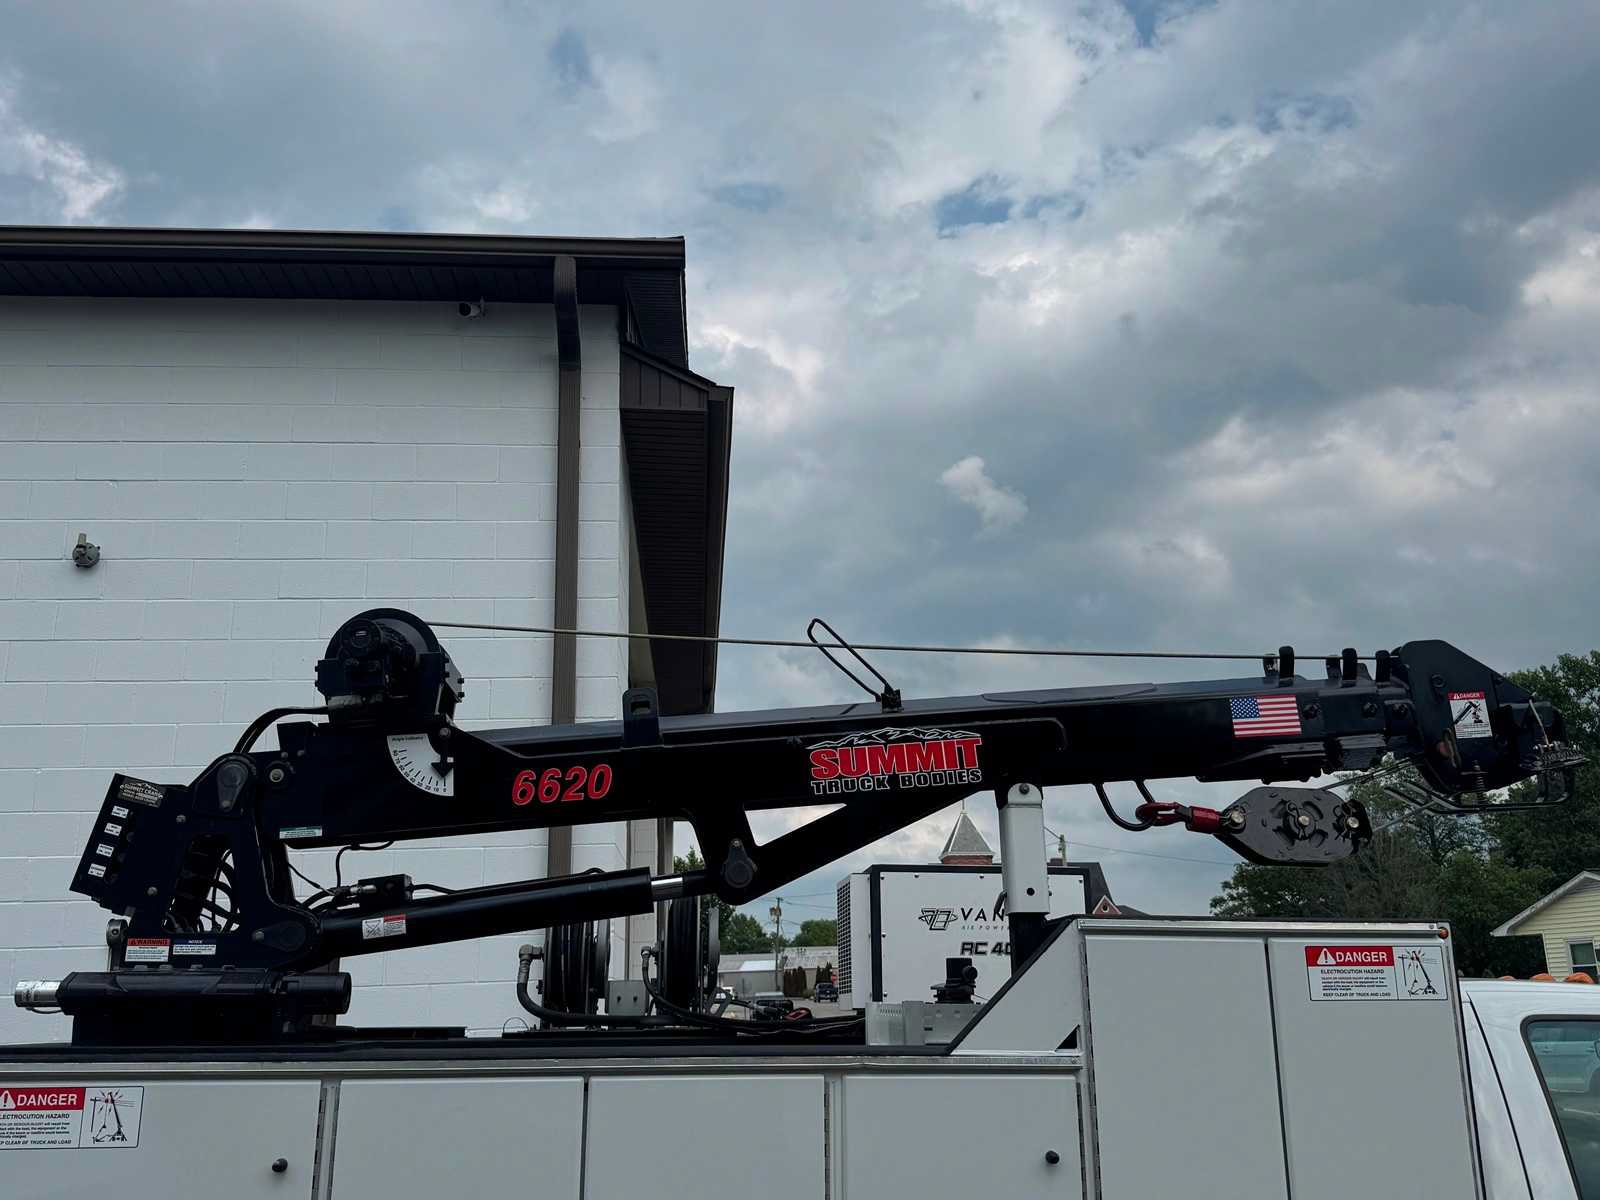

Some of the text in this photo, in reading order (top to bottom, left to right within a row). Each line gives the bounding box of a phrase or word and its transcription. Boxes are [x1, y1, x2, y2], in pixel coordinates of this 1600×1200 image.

[809, 738, 983, 779] SUMMIT
[511, 763, 613, 806] 6620
[811, 769, 982, 795] TRUCK BODIES
[1336, 951, 1388, 962] DANGER
[17, 1093, 77, 1106] DANGER
